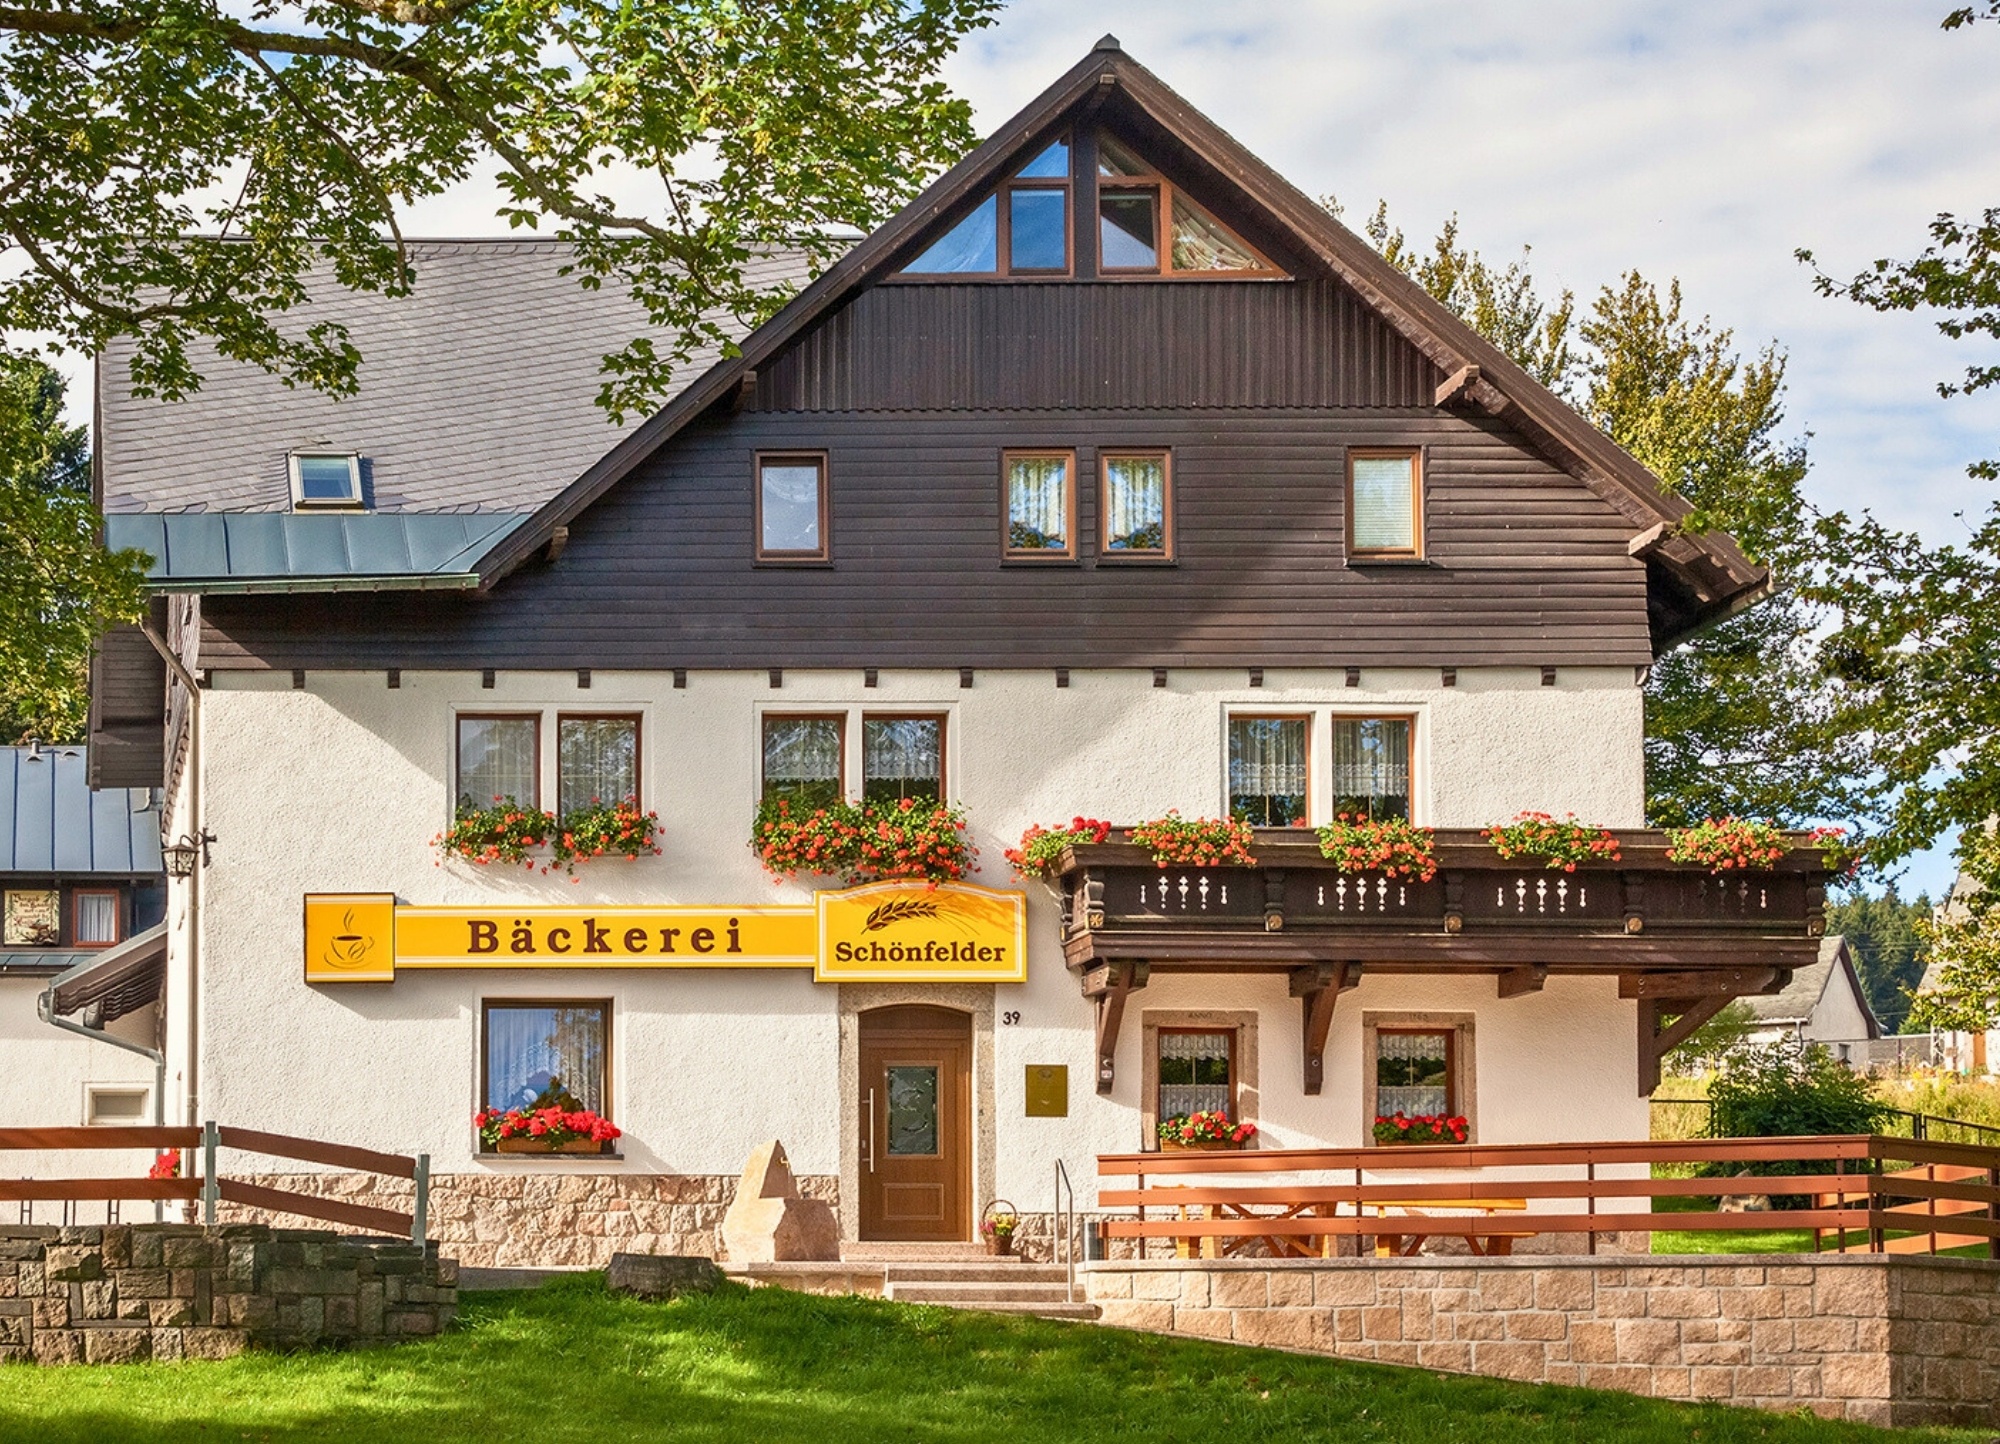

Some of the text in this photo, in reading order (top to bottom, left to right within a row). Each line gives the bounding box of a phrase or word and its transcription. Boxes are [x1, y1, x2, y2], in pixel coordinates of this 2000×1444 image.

[467, 917, 742, 954] Bäckerei
[835, 940, 1006, 963] Schönfelder
[1002, 1011, 1021, 1026] 39
